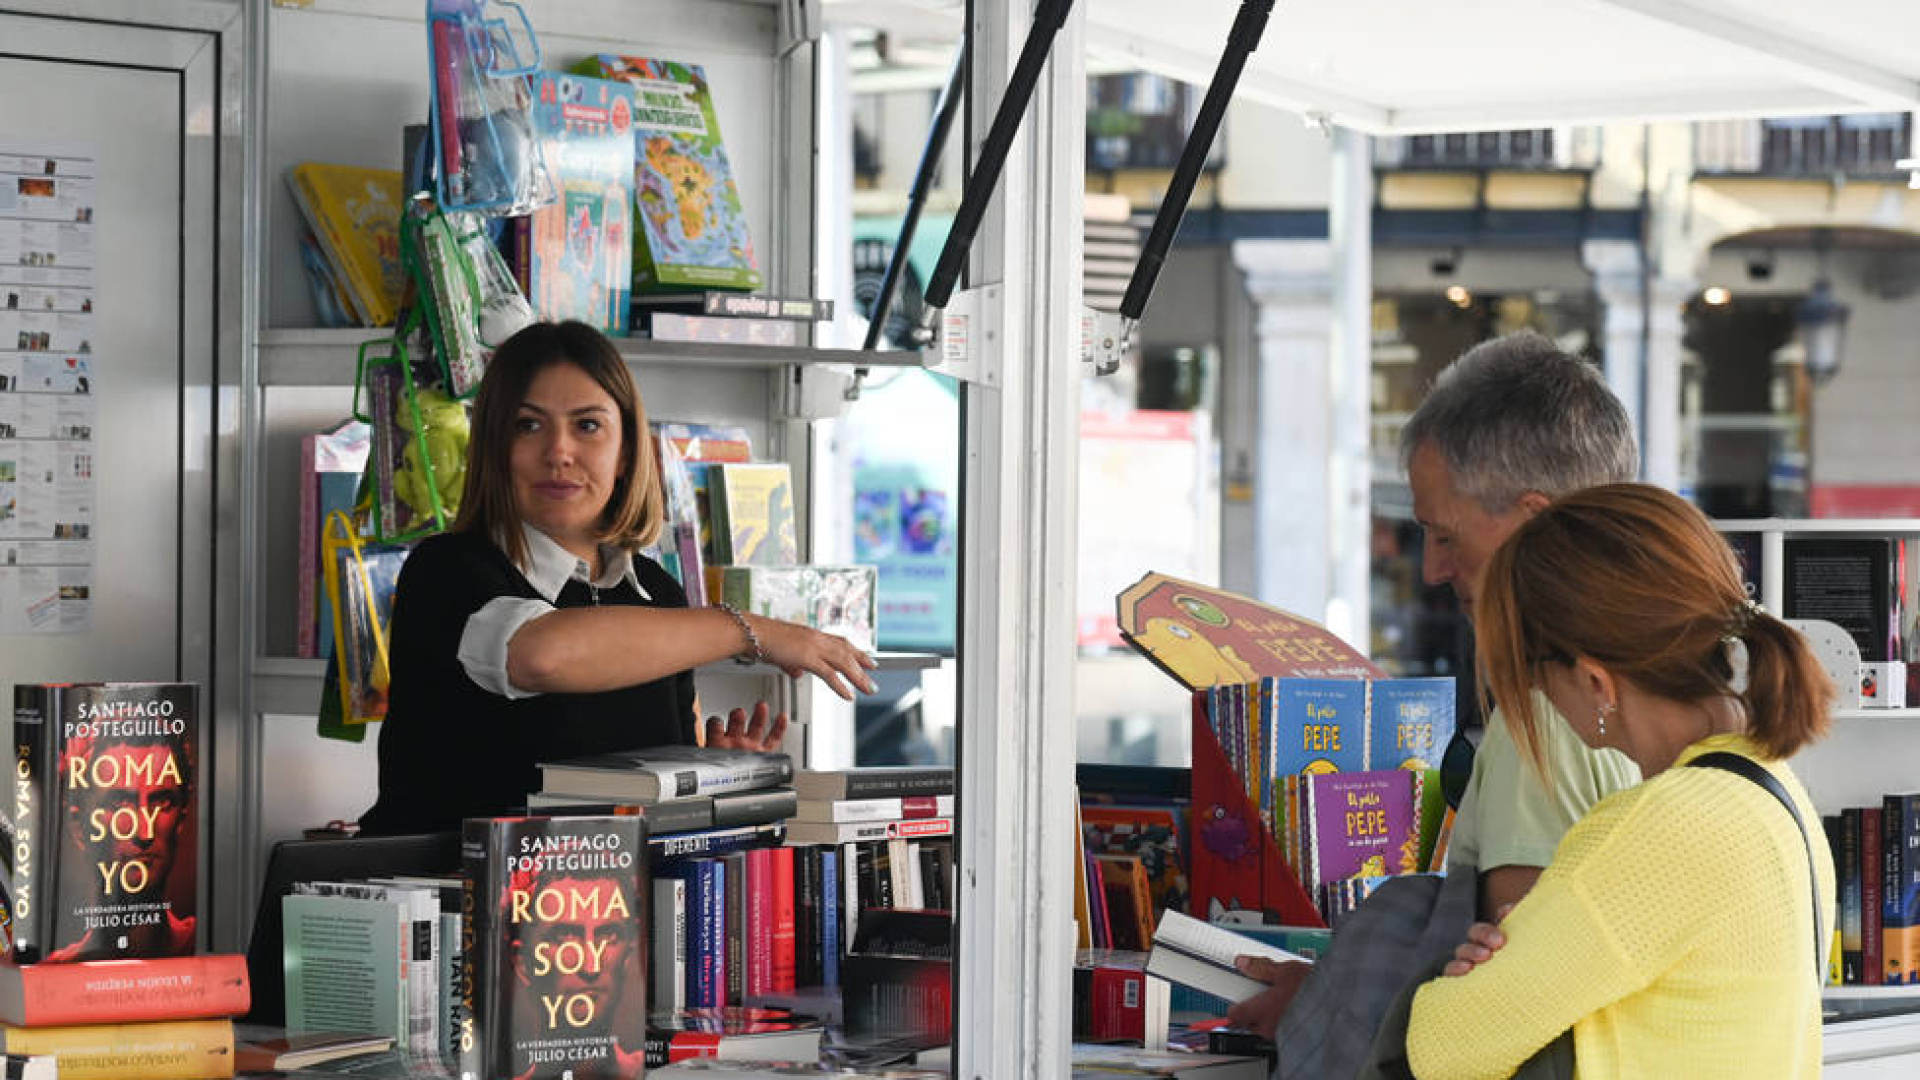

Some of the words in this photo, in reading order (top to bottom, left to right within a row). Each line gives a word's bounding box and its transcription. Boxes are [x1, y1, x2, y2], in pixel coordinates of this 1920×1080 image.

[77, 700, 174, 719] SANTIAGO
[64, 719, 186, 739] POSTEGUILLO
[1304, 724, 1342, 752] PEPE
[1397, 723, 1433, 750] PEPE
[17, 743, 31, 820] ROMA
[69, 750, 182, 790] ROMA
[89, 806, 161, 843] SOY
[1345, 809, 1388, 837] PEPE
[16, 829, 30, 878] SOY
[520, 833, 620, 853] SANTIAGO
[97, 859, 149, 896] YO
[506, 851, 633, 873] POSTEGUILLO
[15, 884, 29, 919] YO
[462, 879, 474, 952] ROMA
[511, 887, 631, 924] ROMA
[84, 914, 121, 930] JULIO
[122, 912, 161, 927] CÉSAR
[533, 939, 608, 977] SOY
[462, 962, 474, 1011] SOY
[541, 993, 595, 1030] YO
[461, 1017, 473, 1053] YO
[527, 1049, 566, 1065] JULIO
[567, 1045, 608, 1061] CÉSAR
